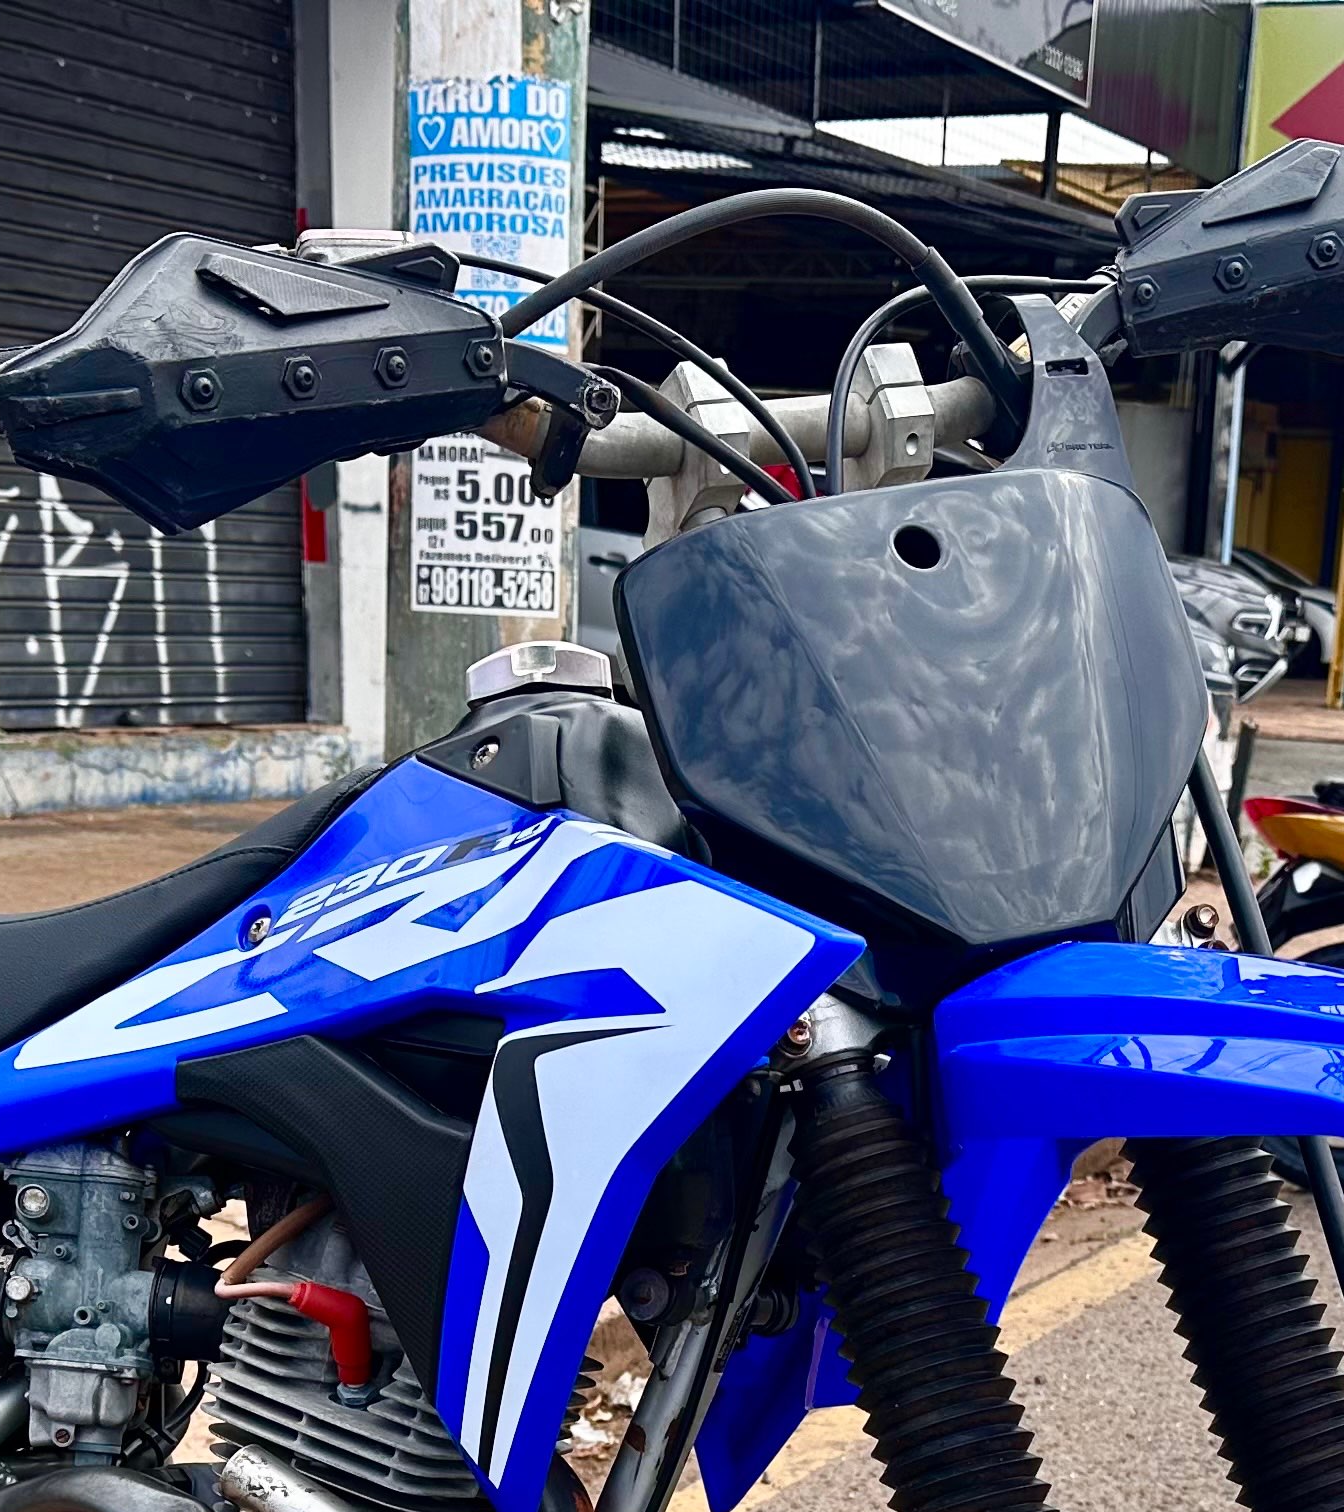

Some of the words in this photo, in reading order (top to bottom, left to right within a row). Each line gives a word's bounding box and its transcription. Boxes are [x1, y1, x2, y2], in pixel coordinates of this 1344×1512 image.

[416, 80, 516, 116] TAROT
[526, 85, 566, 120] DO
[450, 117, 541, 151] AMOR
[413, 160, 566, 188] PREVISÕES
[414, 187, 565, 216] AMARRAÇÃO
[414, 211, 565, 239] AMOROSA
[431, 566, 554, 611] 98118-5258
